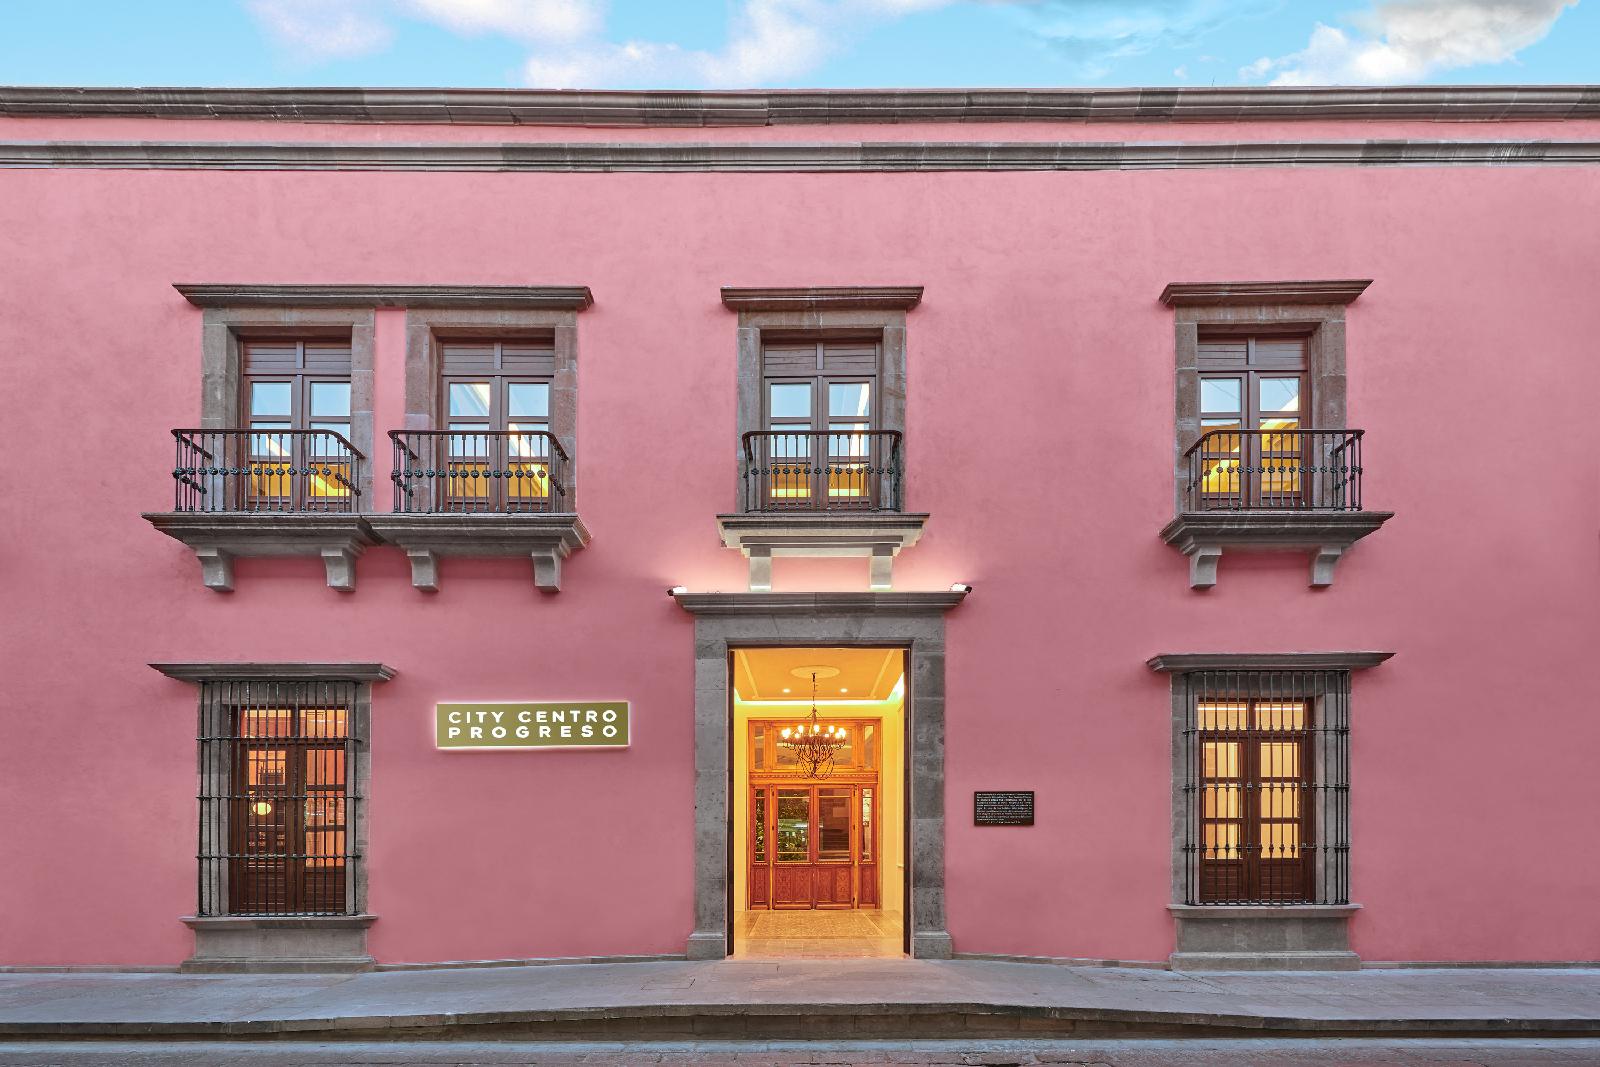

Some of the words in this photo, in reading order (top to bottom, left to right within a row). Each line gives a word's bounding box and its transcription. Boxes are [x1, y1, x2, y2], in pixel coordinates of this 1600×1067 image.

[448, 711, 505, 724] CITY
[518, 710, 617, 723] CENTRO
[448, 725, 617, 739] PROGRESO
